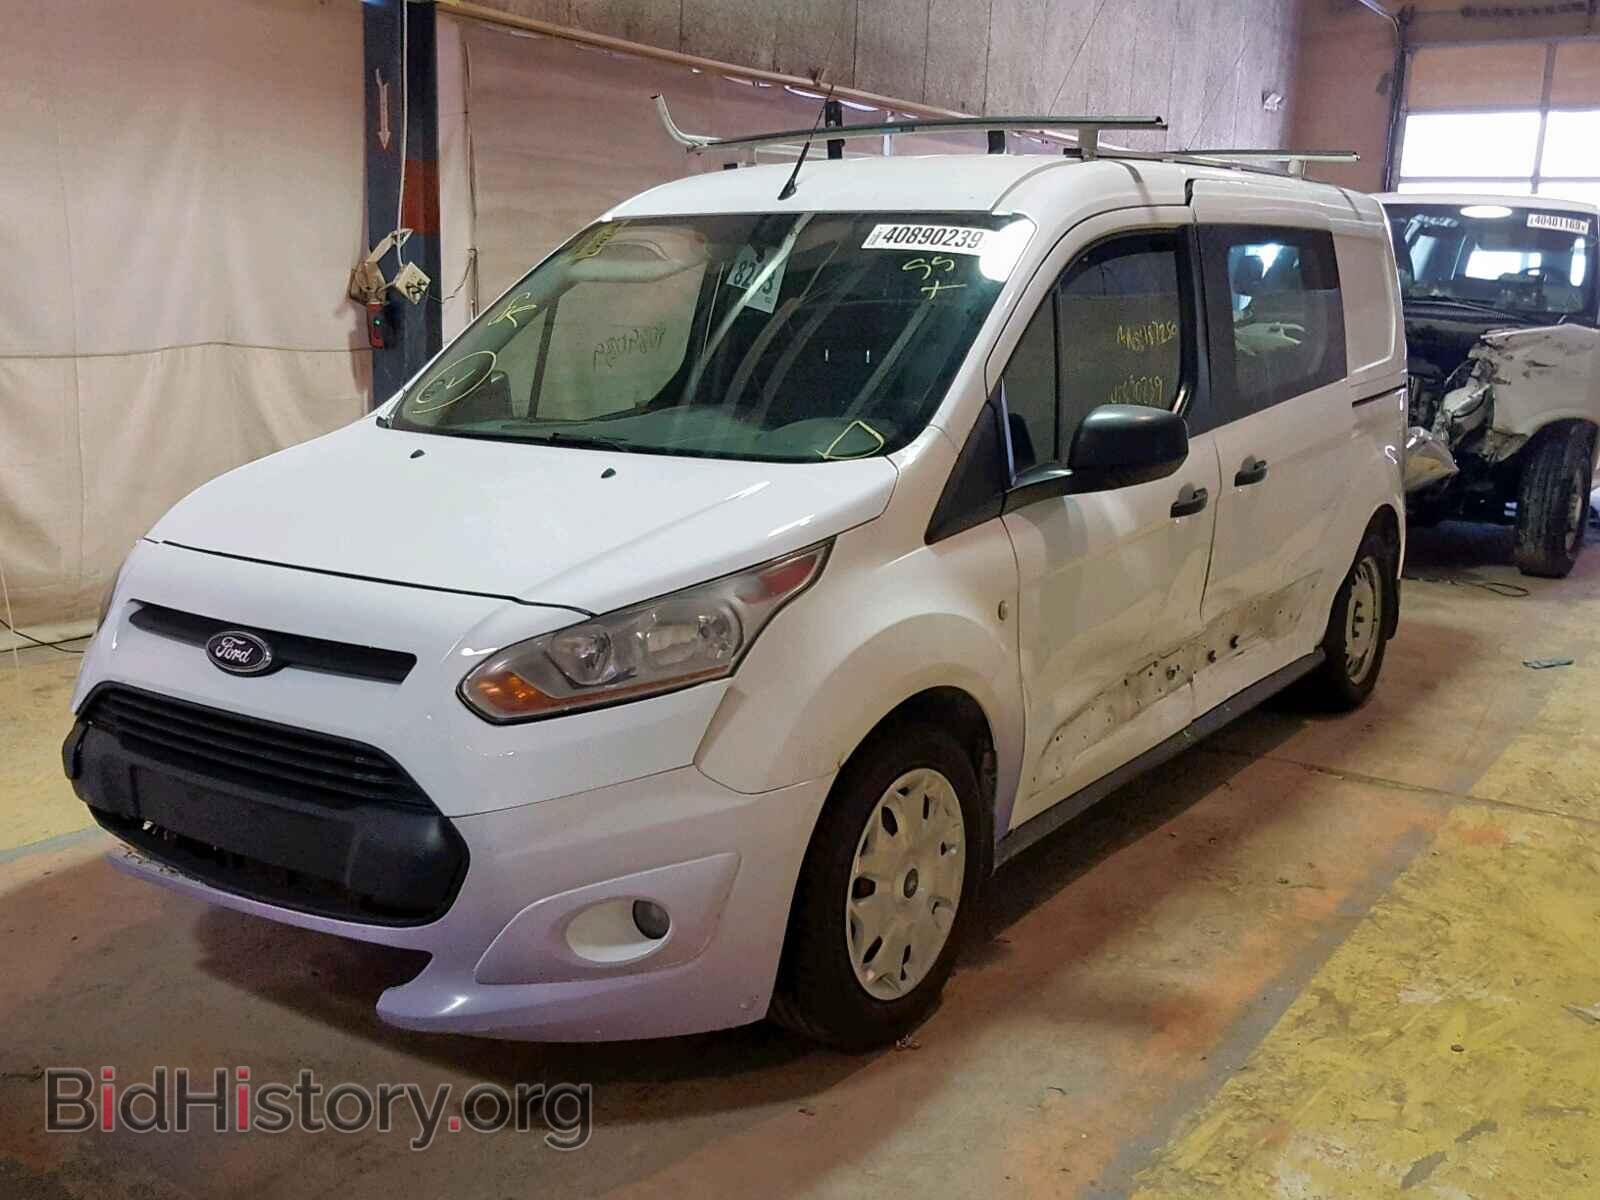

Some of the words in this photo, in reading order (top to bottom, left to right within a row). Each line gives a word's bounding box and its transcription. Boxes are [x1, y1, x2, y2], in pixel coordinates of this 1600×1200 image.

[882, 226, 984, 249] 40890239
[734, 261, 775, 294] 823
[215, 636, 254, 663] Ford
